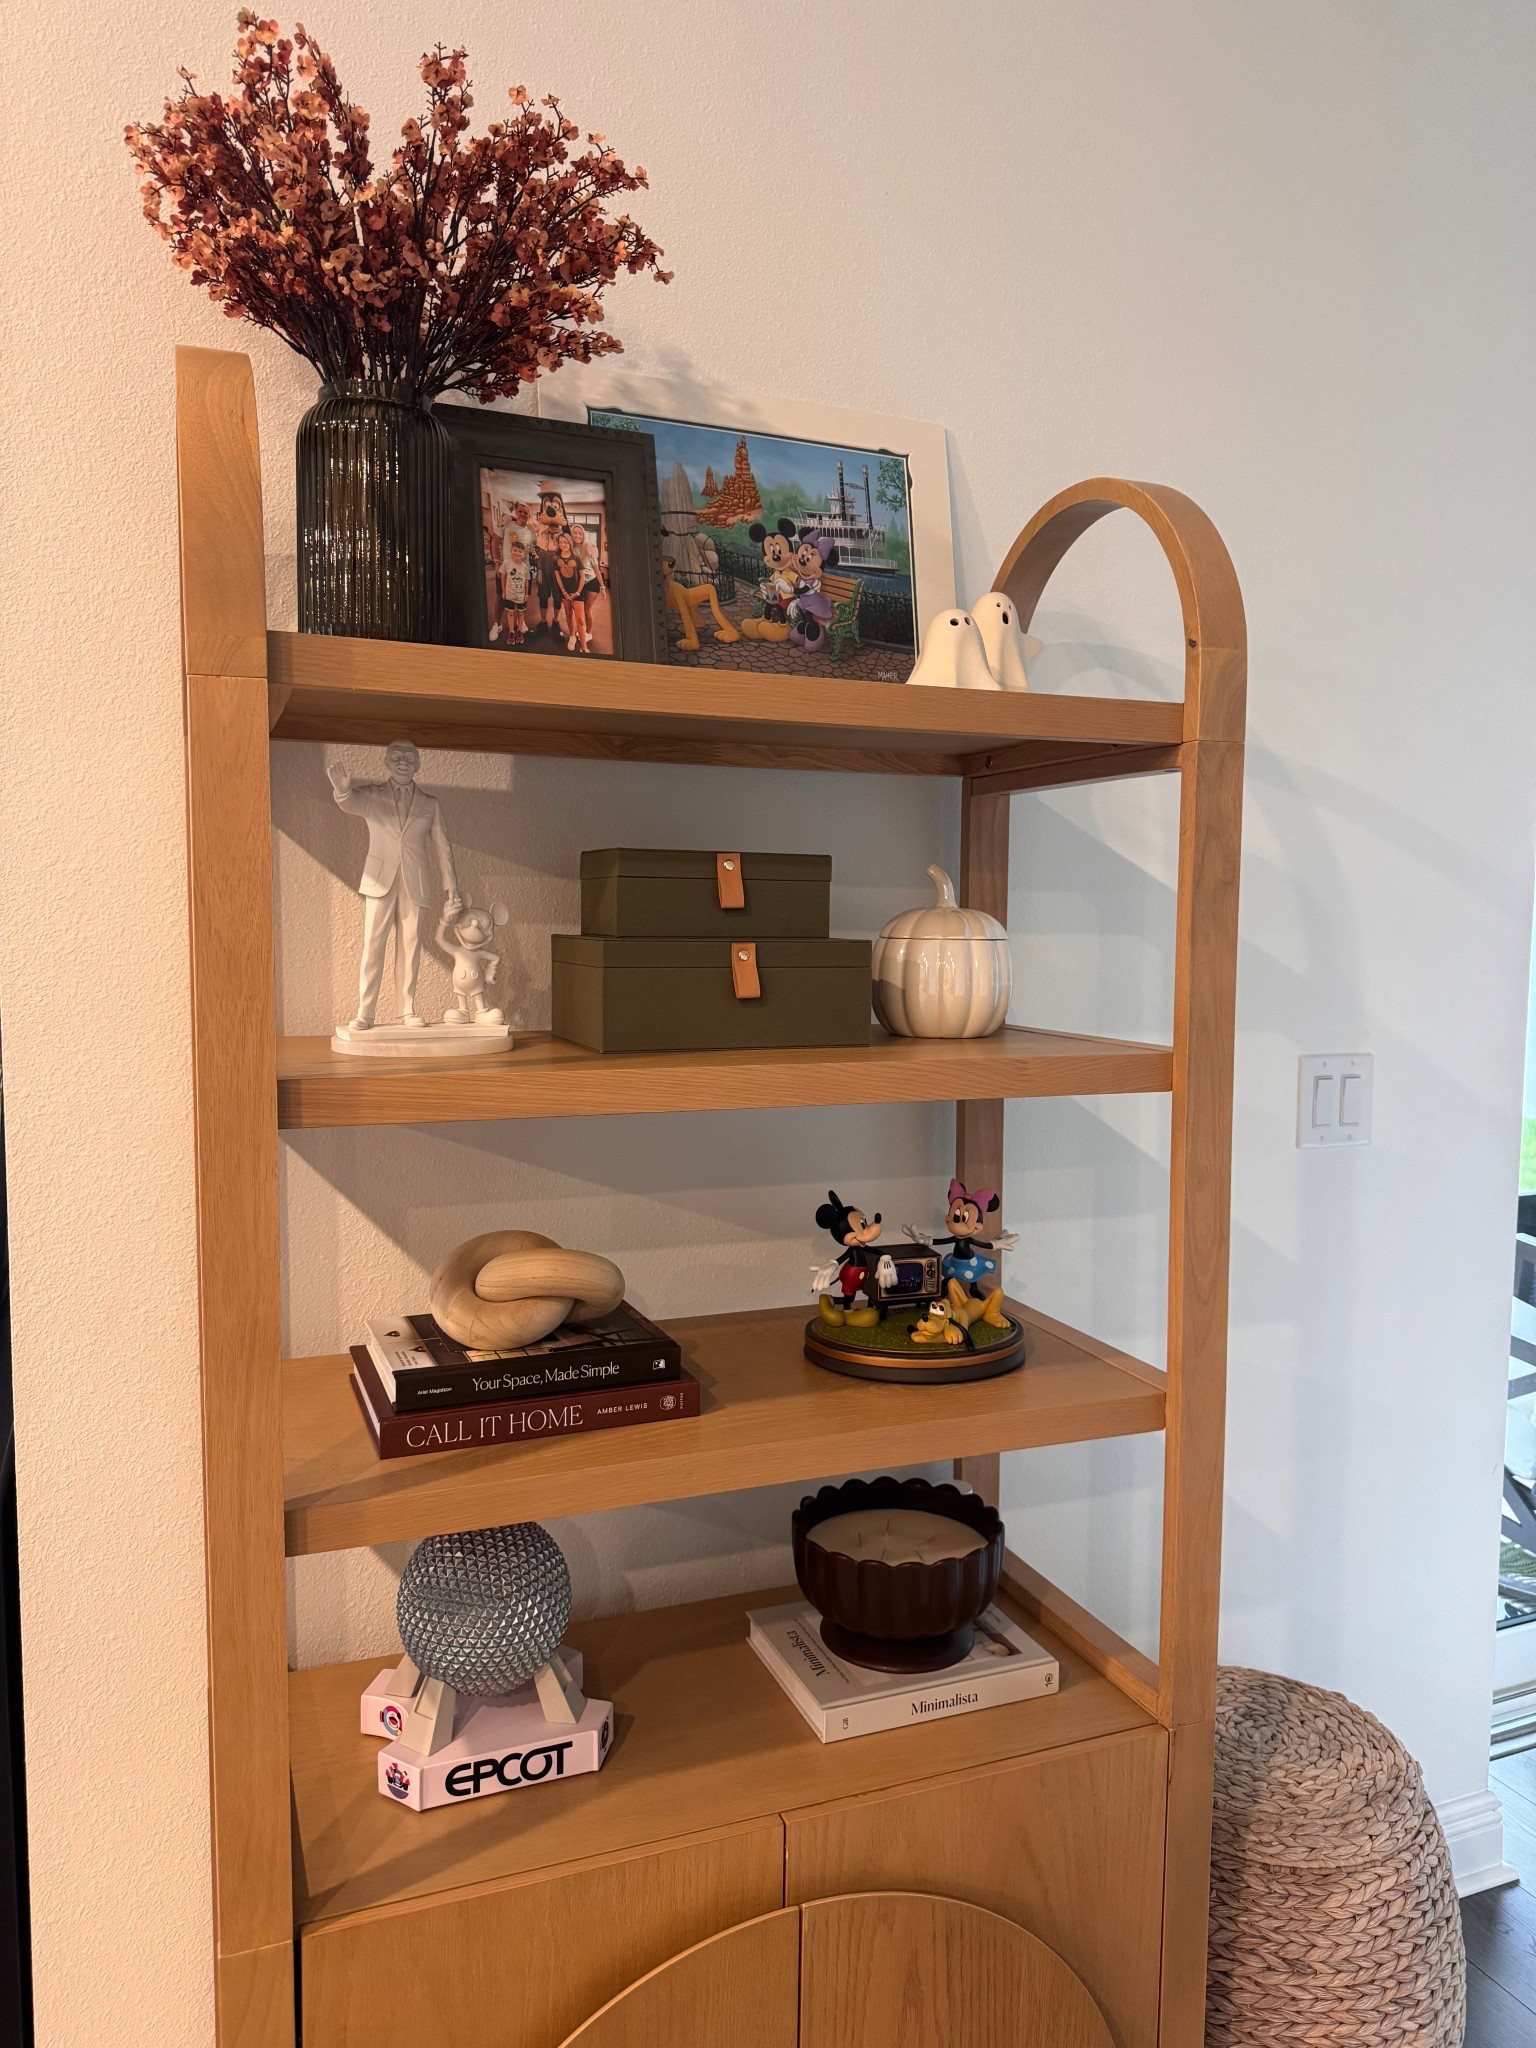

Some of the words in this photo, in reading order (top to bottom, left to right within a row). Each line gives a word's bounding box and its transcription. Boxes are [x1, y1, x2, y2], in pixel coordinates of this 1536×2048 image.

[472, 1377, 501, 1391] Your
[502, 1373, 543, 1390] Space,
[545, 1366, 579, 1383] Made
[580, 1361, 620, 1379] Simple
[406, 1420, 472, 1448] CALL
[480, 1415, 502, 1438] IT
[509, 1404, 584, 1434] HOME
[596, 1405, 623, 1415] AMBER
[625, 1402, 648, 1412] LEWIS
[786, 1630, 830, 1676] Minimalista
[911, 1693, 979, 1715] Minimalista
[444, 1740, 574, 1797] EPCOT
